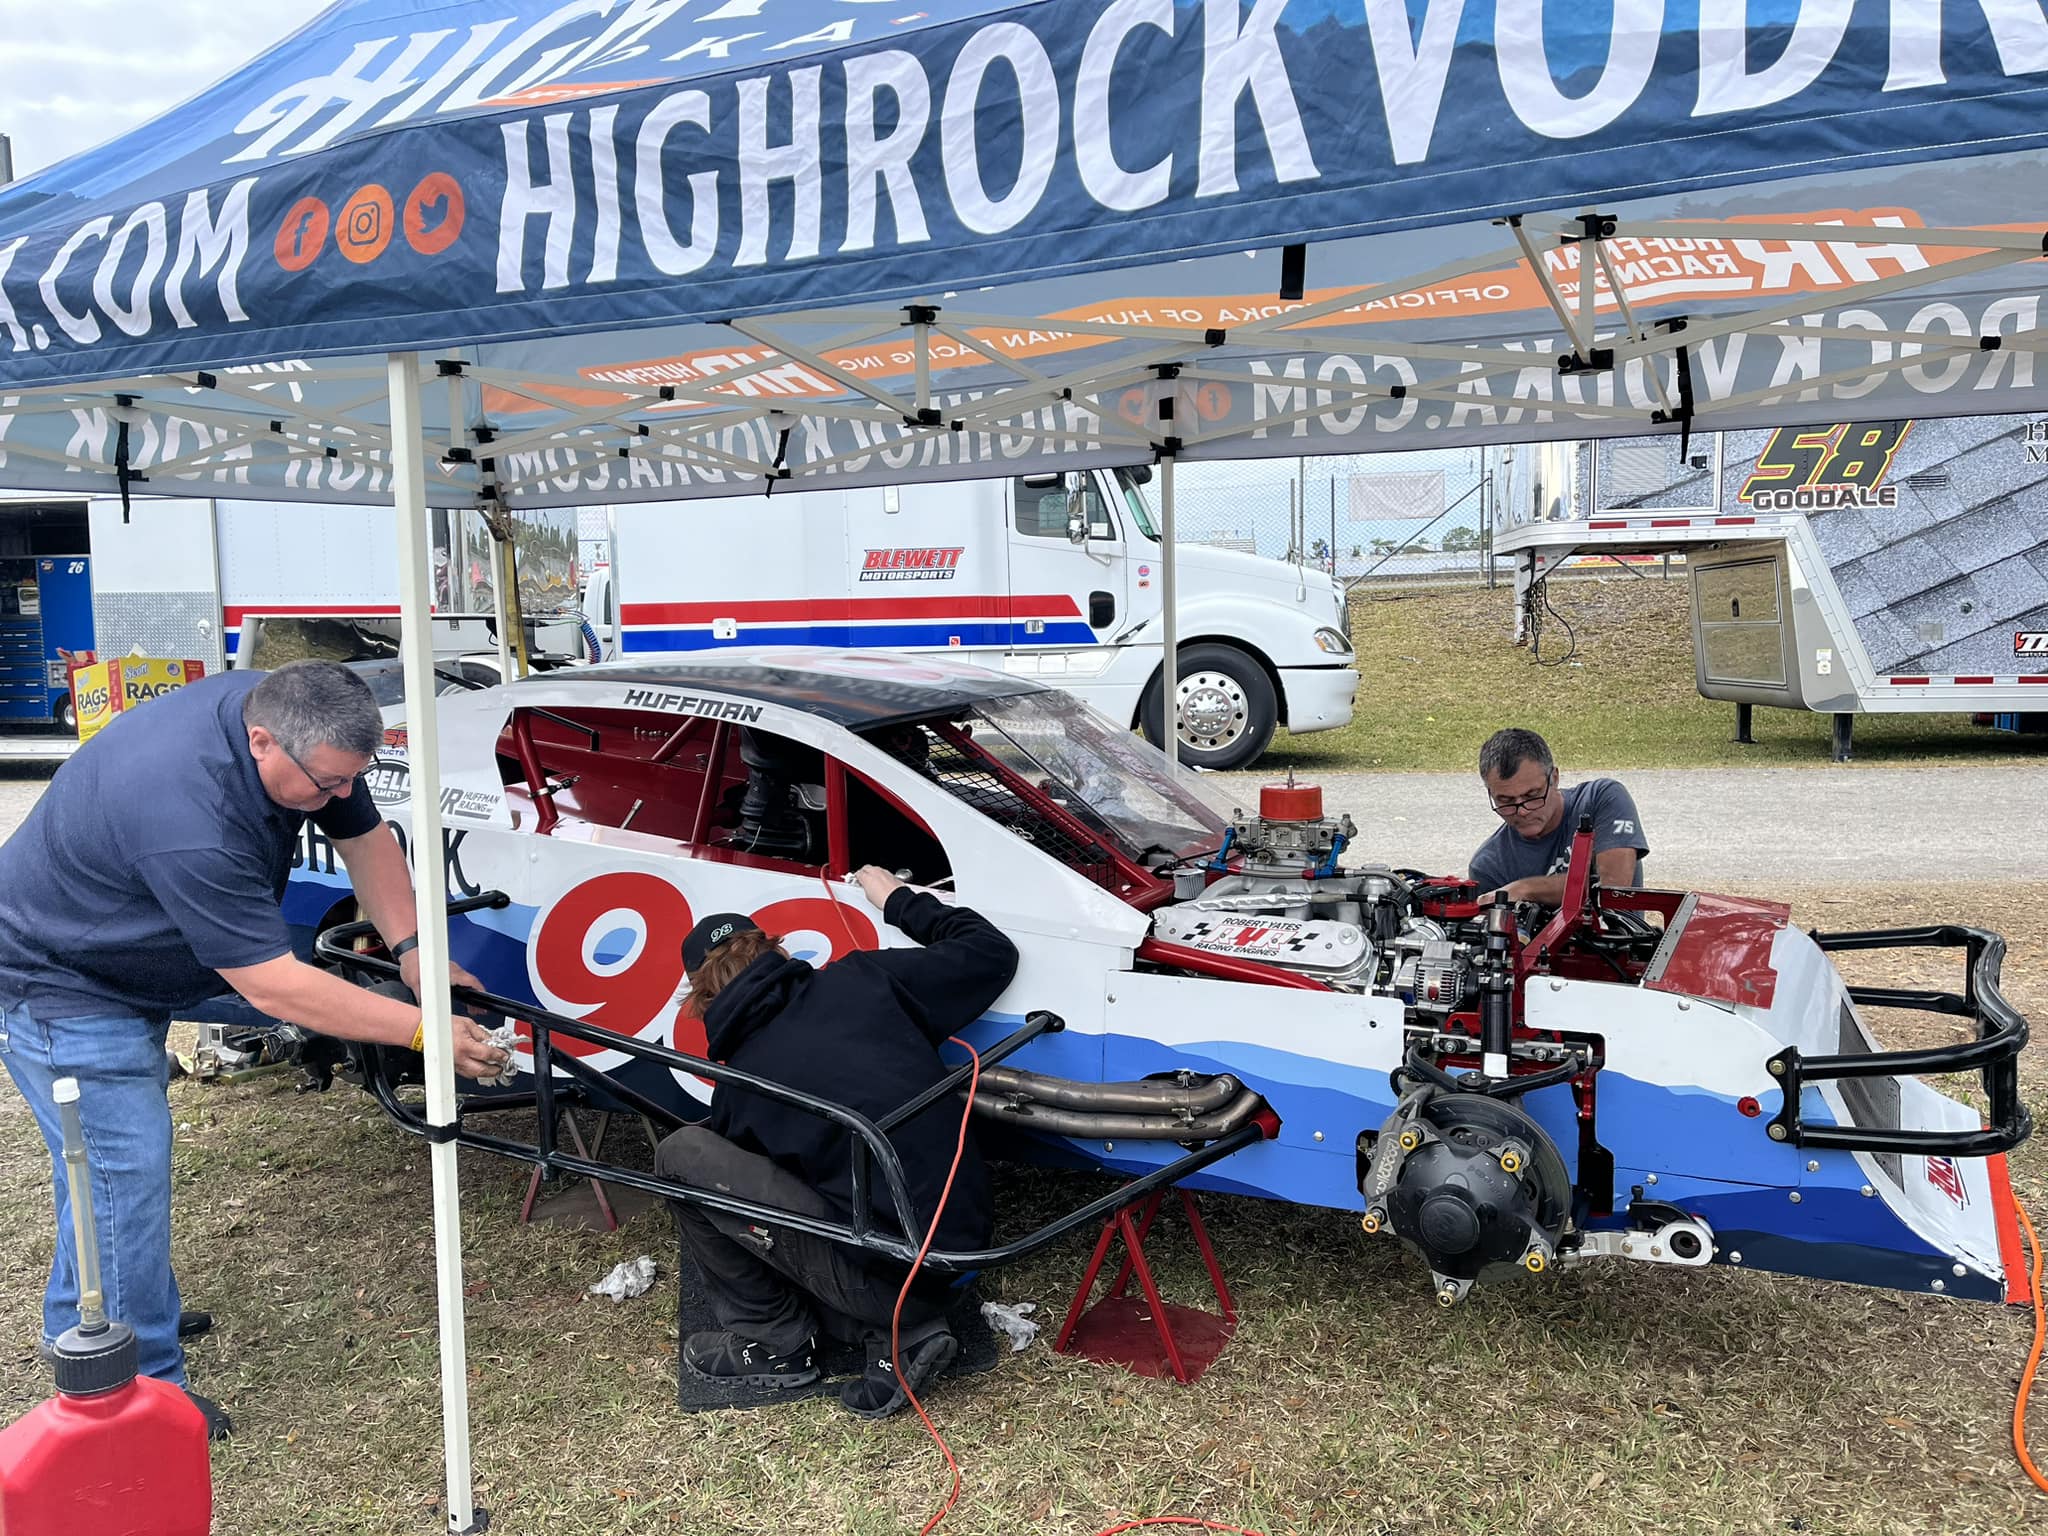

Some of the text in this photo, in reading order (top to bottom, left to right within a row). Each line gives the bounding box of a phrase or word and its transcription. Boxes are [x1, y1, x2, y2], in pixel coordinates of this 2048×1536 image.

[1738, 420, 1914, 503] 58
[1752, 486, 1897, 512] GOODALE
[862, 546, 966, 570] BLEWETT
[67, 561, 85, 574] 76
[861, 570, 954, 581] MOTORSPORTS
[77, 686, 109, 711] RAGS
[623, 688, 765, 723] HUFFMAN
[364, 767, 411, 791] BELL
[458, 801, 488, 813] RACING
[463, 791, 501, 805] HUFFMAN
[1612, 819, 1635, 835] 75
[710, 922, 733, 943] 98
[1221, 917, 1303, 931] ROBERT YATES
[1193, 942, 1280, 957] RACING ENGINES
